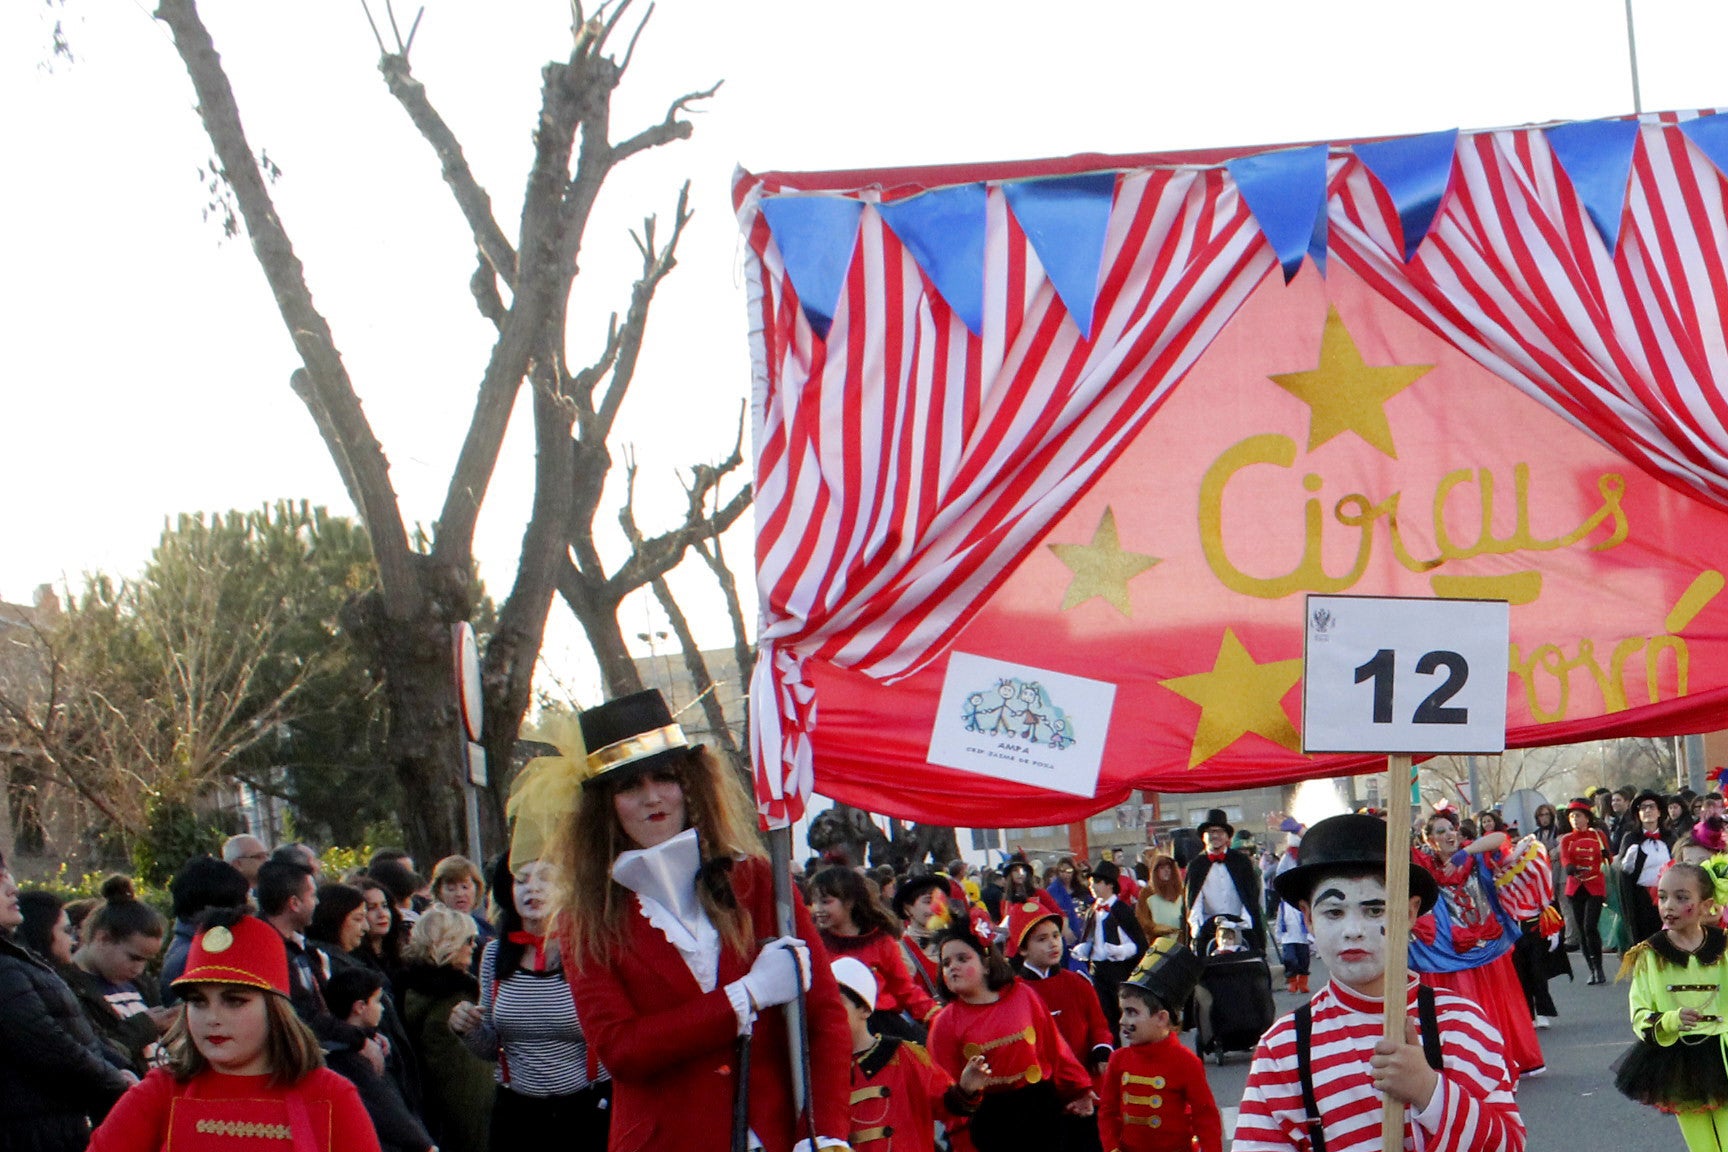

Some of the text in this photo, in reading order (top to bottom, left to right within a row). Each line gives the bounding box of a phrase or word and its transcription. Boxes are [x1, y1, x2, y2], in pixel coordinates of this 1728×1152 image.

[1198, 432, 1629, 600] Circus
[1354, 648, 1469, 725] 12
[998, 743, 1029, 754] AMPA
